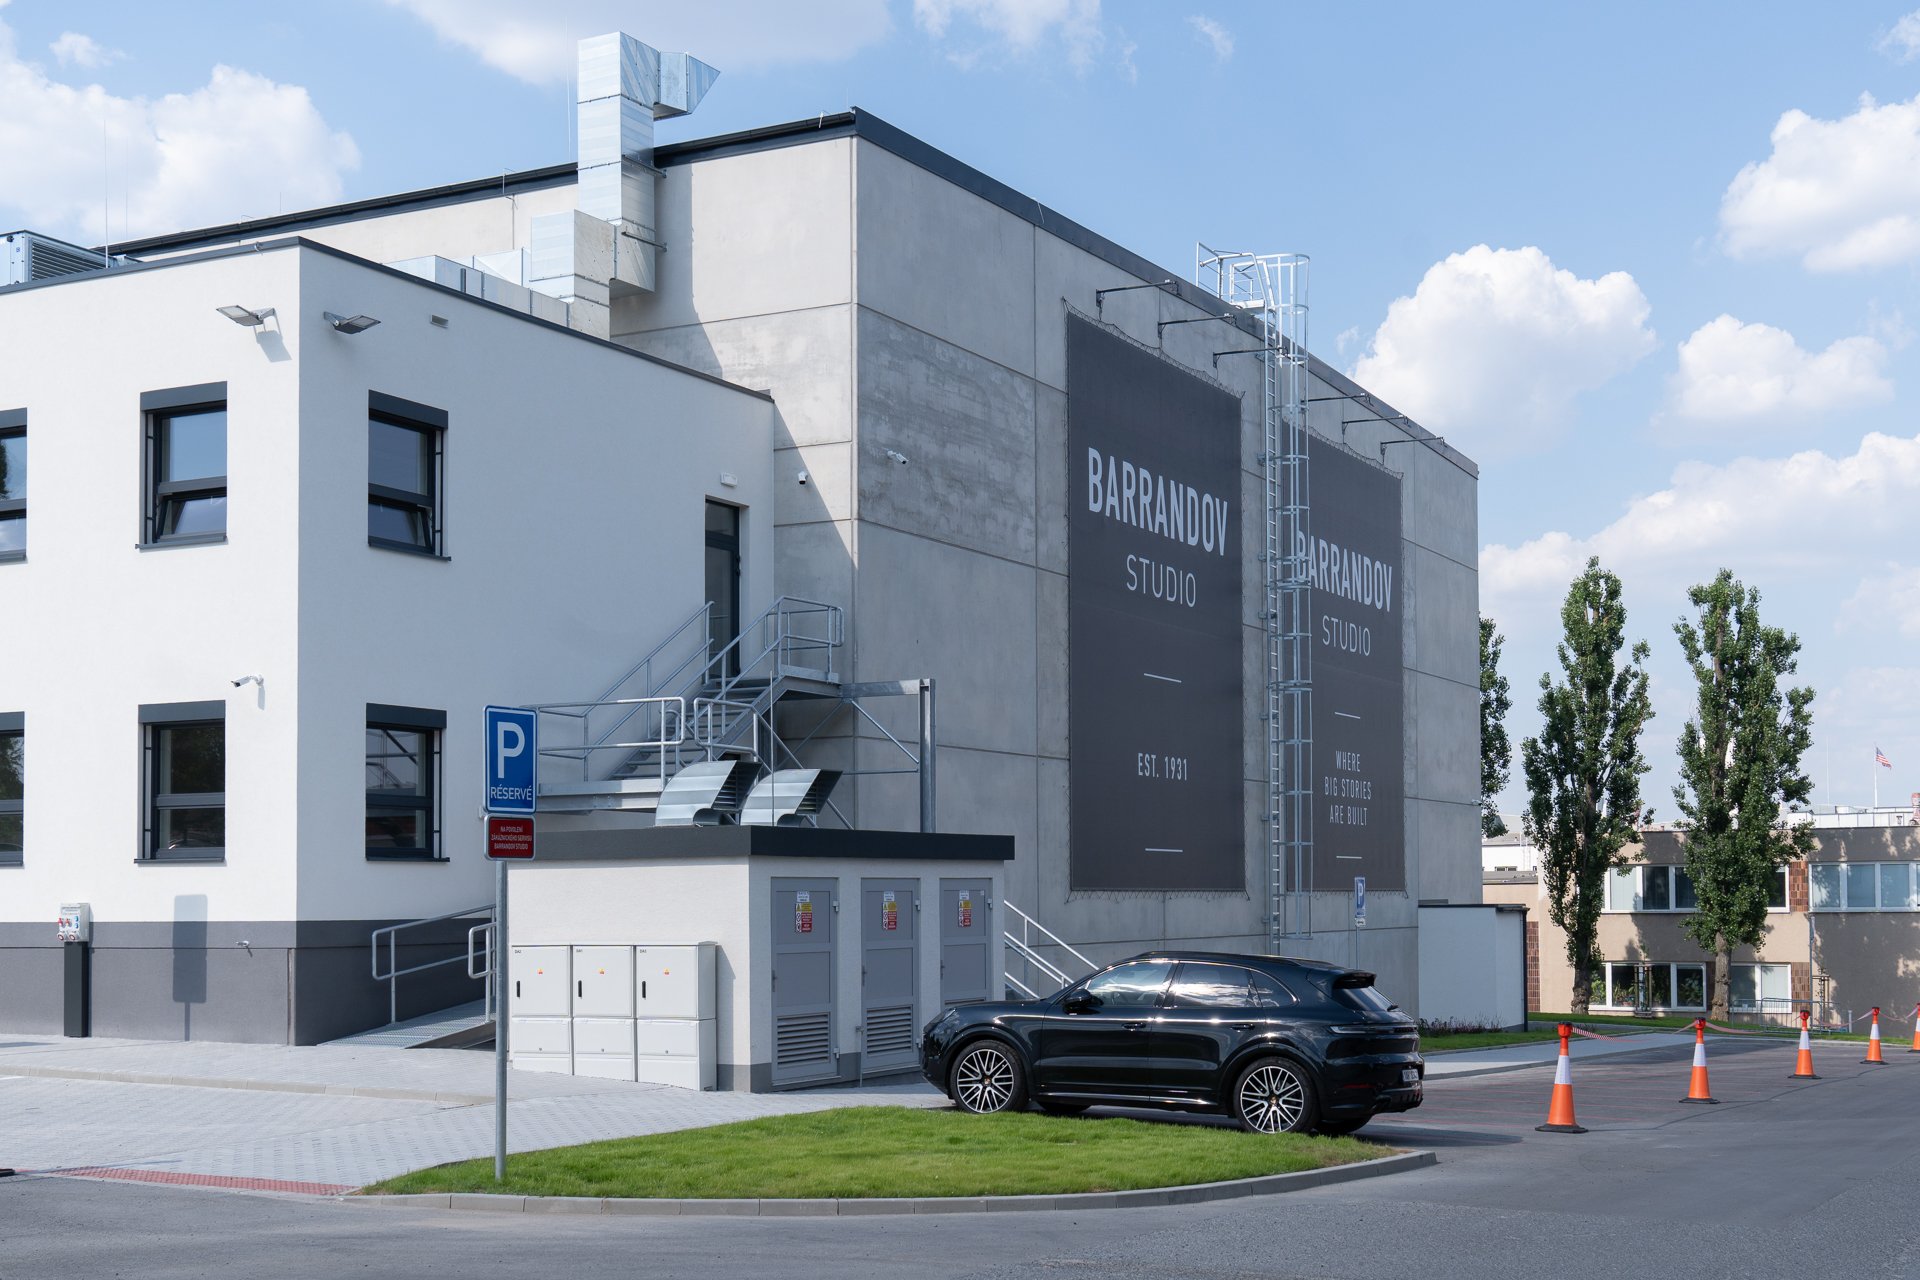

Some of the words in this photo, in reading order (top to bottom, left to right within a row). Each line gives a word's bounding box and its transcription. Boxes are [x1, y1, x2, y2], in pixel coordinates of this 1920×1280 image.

[1088, 447, 1228, 556] BARRANDOV
[1126, 554, 1196, 607] STUDIO
[1297, 530, 1392, 612] BARRANDOV
[1322, 615, 1371, 656] STUDIO
[497, 721, 525, 779] P
[1138, 752, 1159, 778] EST.
[1165, 756, 1187, 781] 1931
[1336, 750, 1361, 772] WHERE
[490, 784, 532, 801] RÉSERVÉ
[1324, 776, 1338, 797] BIG
[1341, 778, 1372, 800] STORIES
[1329, 804, 1344, 824] ARE
[1347, 806, 1367, 826] BUILT
